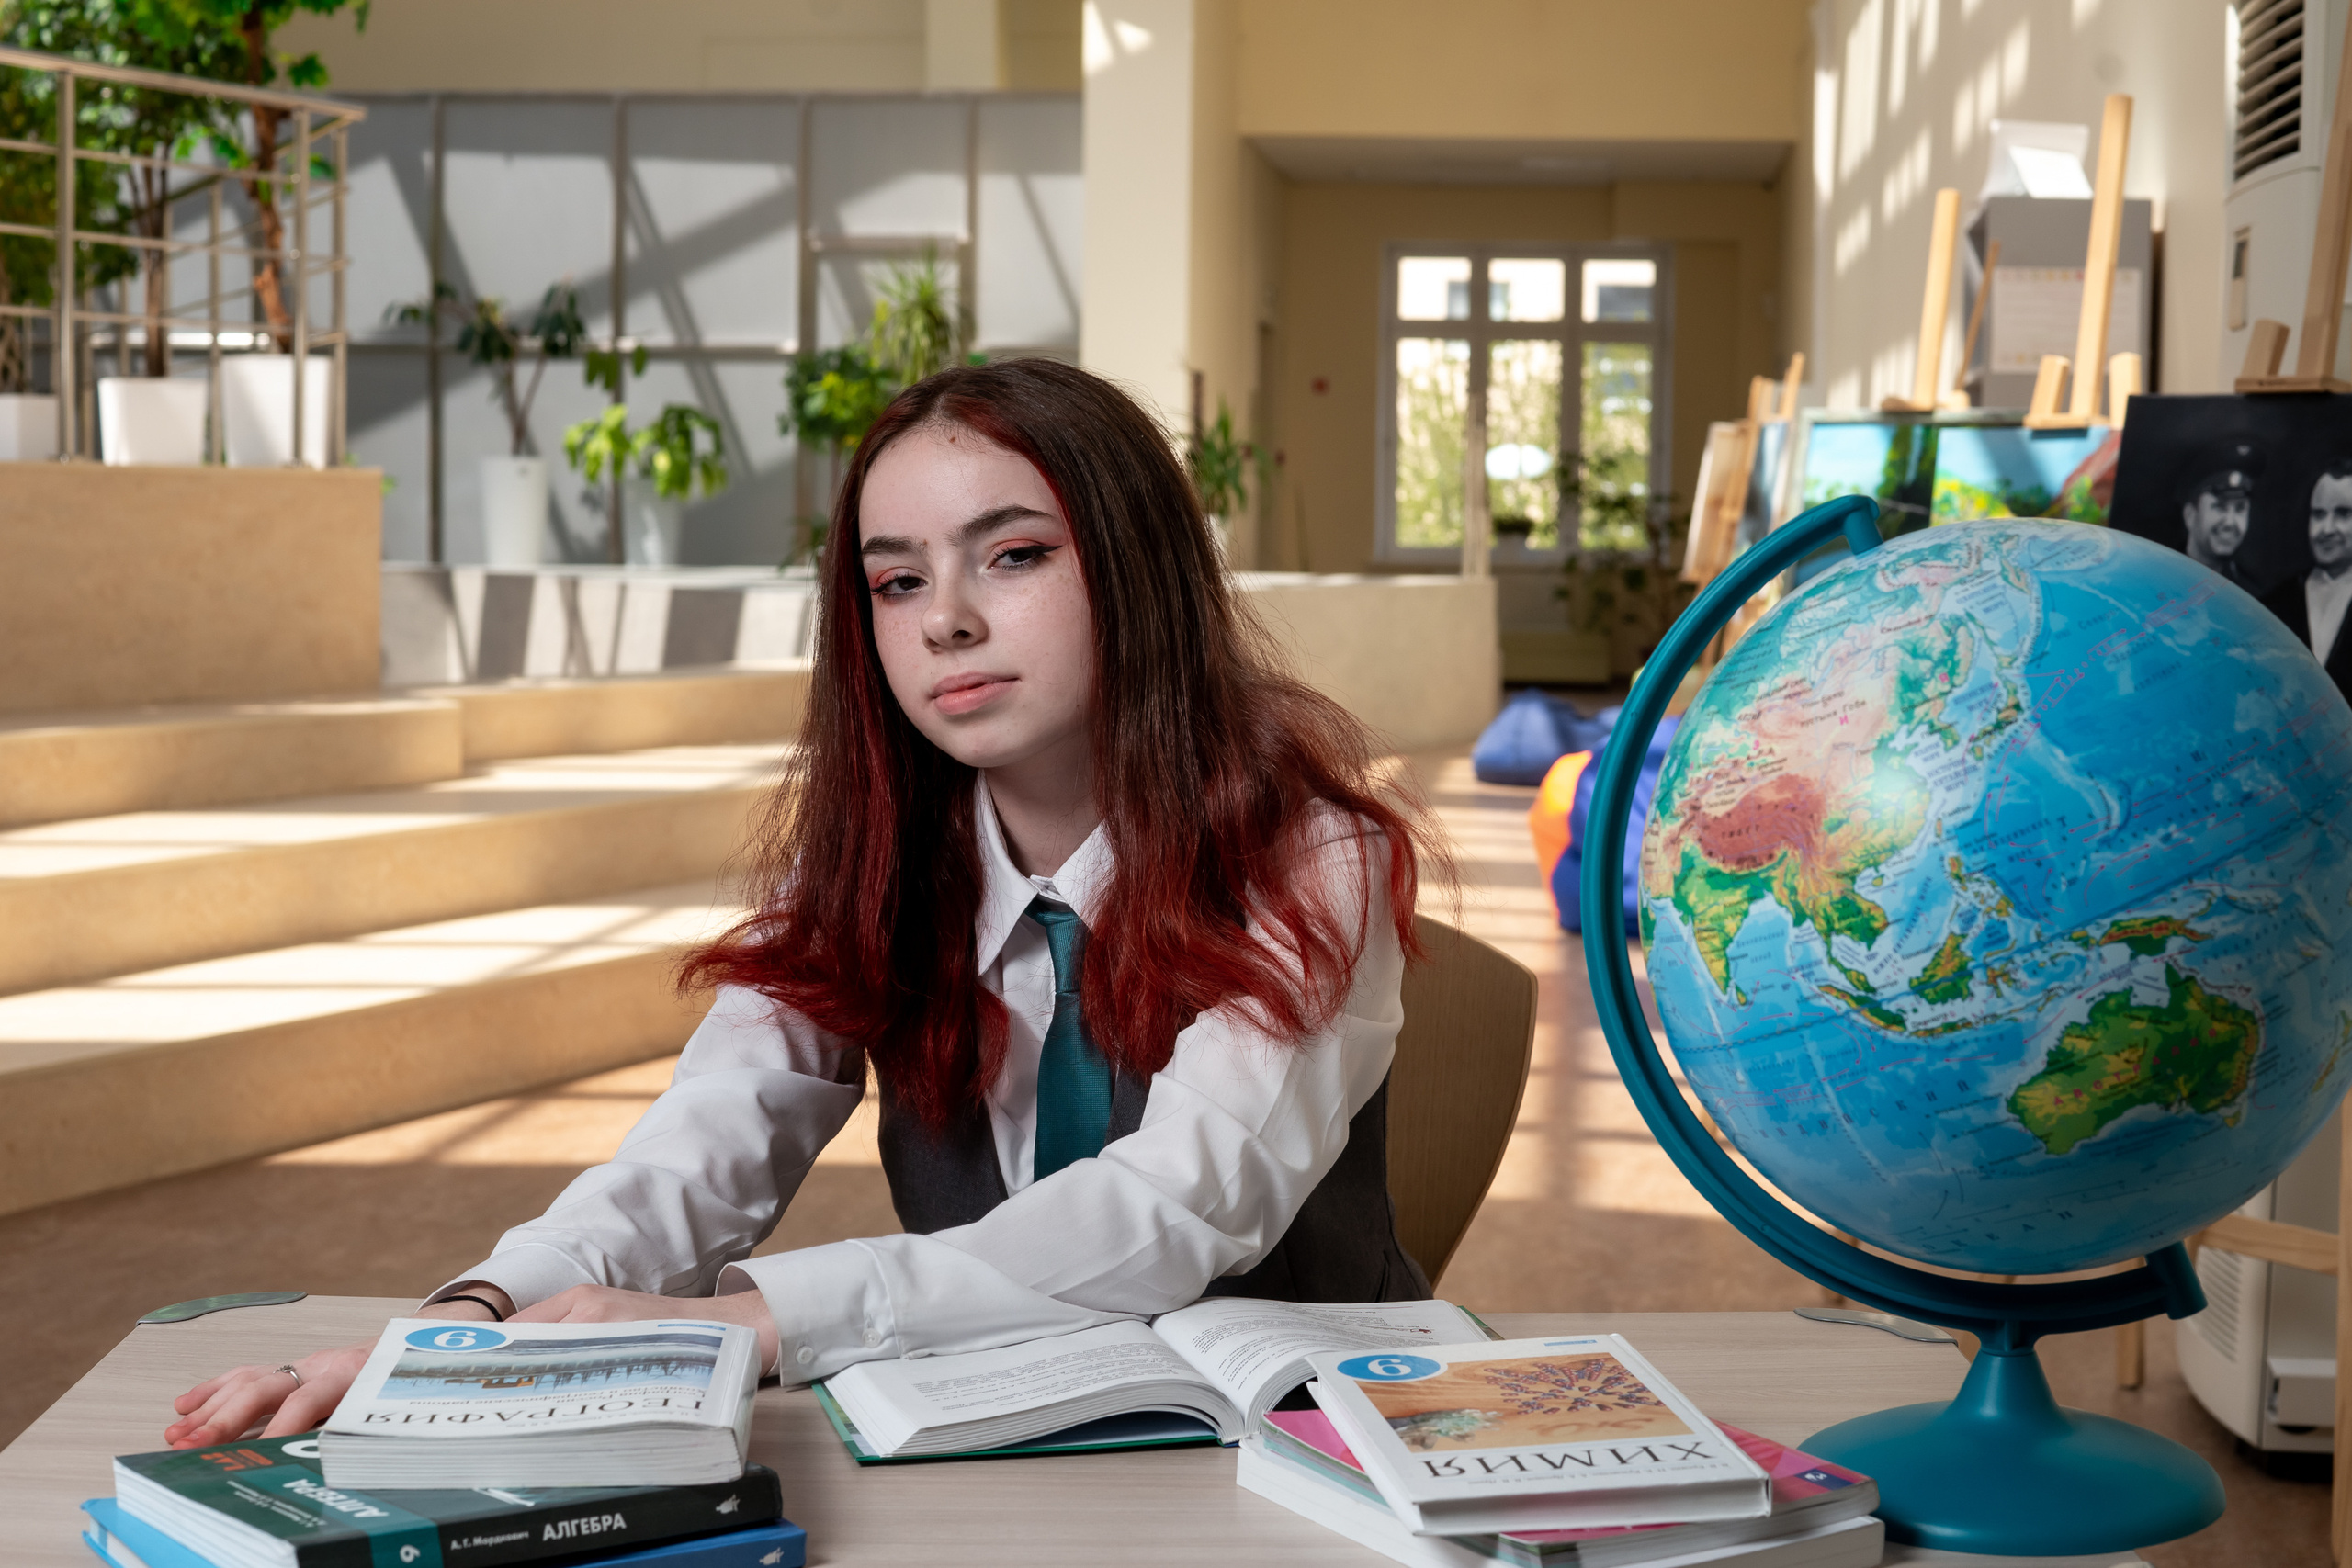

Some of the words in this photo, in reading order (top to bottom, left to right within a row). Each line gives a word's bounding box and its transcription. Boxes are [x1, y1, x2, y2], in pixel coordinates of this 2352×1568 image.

[434, 1330, 477, 1348] 9
[1368, 1358, 1412, 1376] 9
[364, 1397, 705, 1424] ГЕОГРАФИЯ
[1422, 1441, 1716, 1478] ХИМИЯ
[282, 1478, 390, 1517] АЛГЕБРА
[472, 1531, 529, 1547] Мордкович
[542, 1512, 627, 1541] АЛГЕБРА
